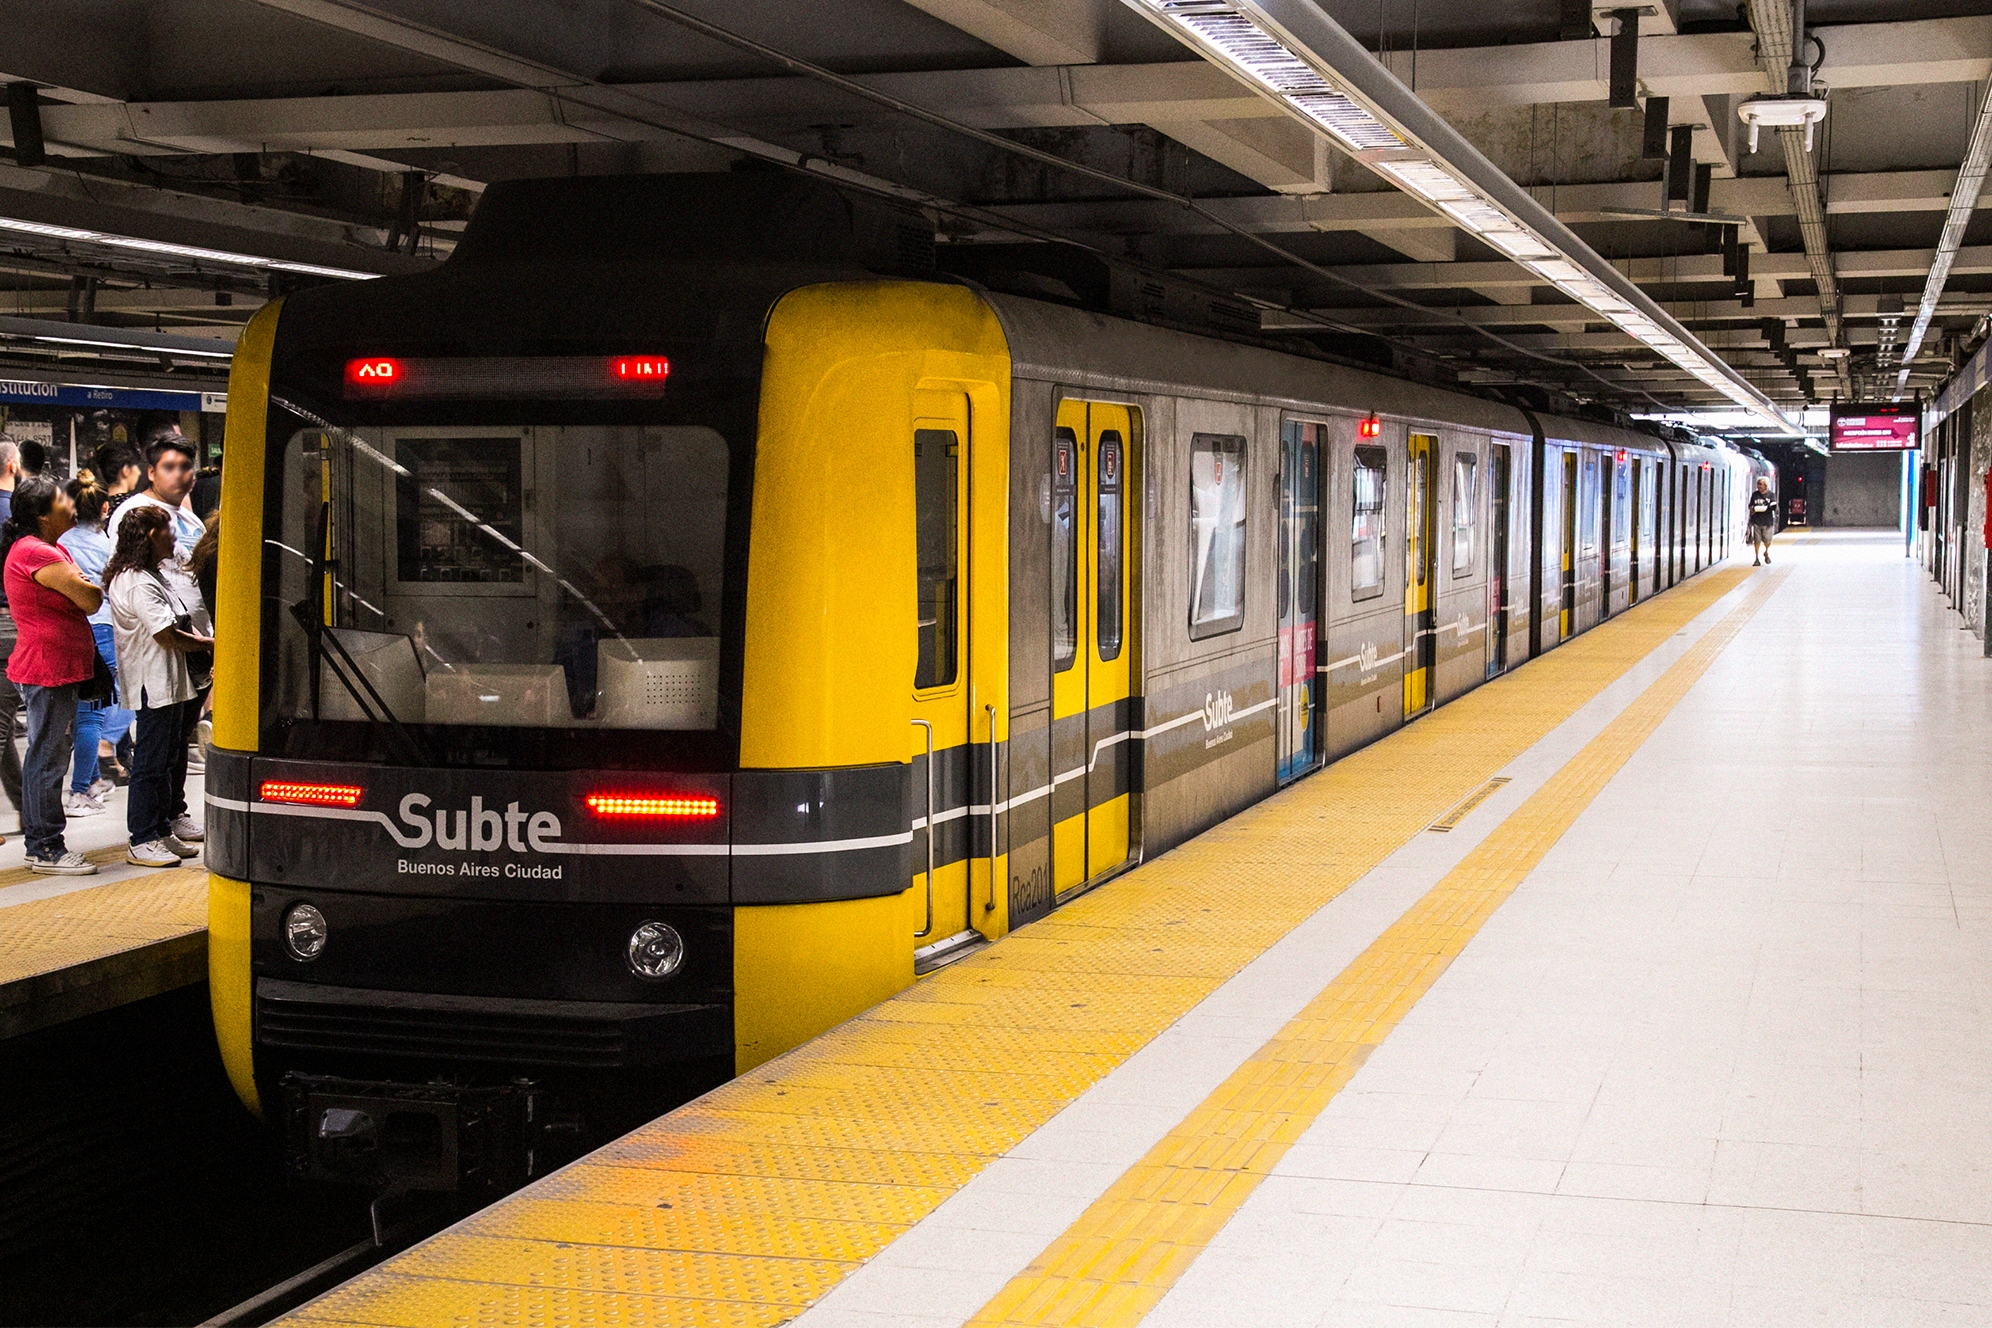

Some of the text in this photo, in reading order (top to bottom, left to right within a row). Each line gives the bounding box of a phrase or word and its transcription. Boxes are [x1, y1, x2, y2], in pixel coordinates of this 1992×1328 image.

[93, 389, 113, 400] Retiro
[1361, 641, 1377, 672] Subte
[1204, 690, 1232, 731] Subte
[399, 793, 562, 853] Subte
[397, 859, 562, 879] Buenos Aires Ciudad
